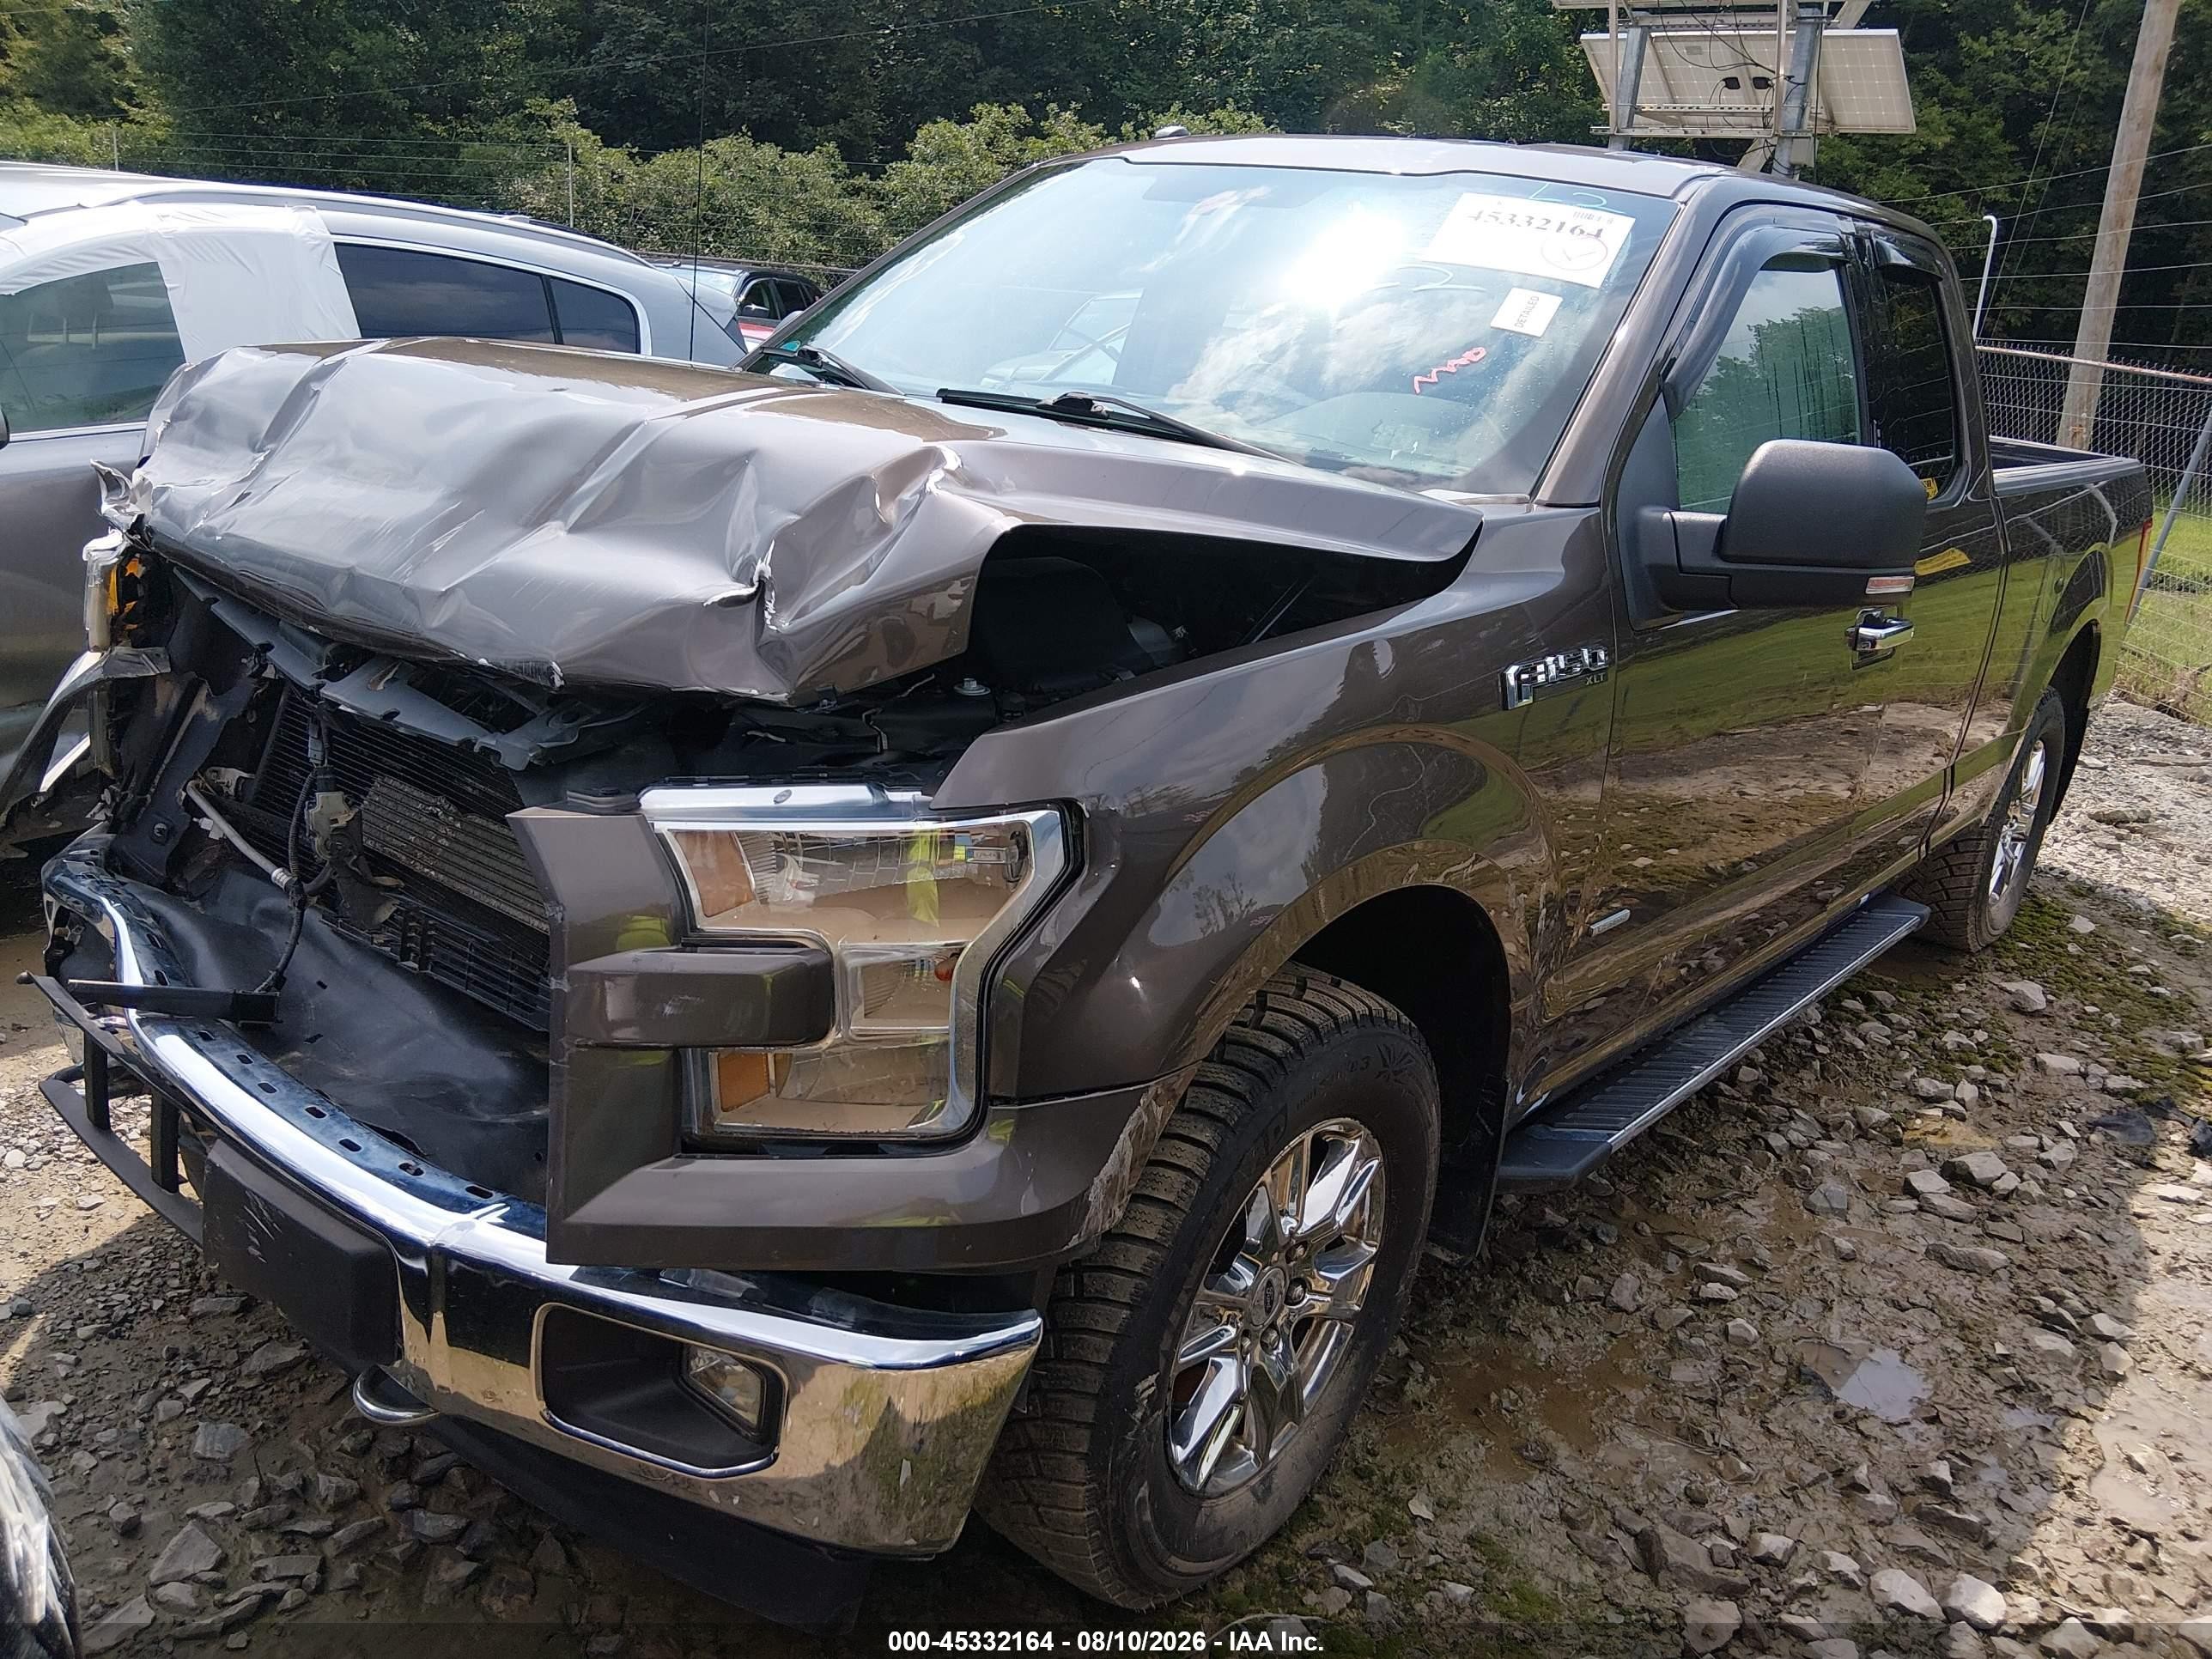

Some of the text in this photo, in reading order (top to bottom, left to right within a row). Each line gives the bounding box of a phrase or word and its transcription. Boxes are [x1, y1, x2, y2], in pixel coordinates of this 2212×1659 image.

[1468, 210, 1604, 240] 45332164
[1514, 295, 1540, 329] DETAILED
[1585, 672, 1606, 686] XLT
